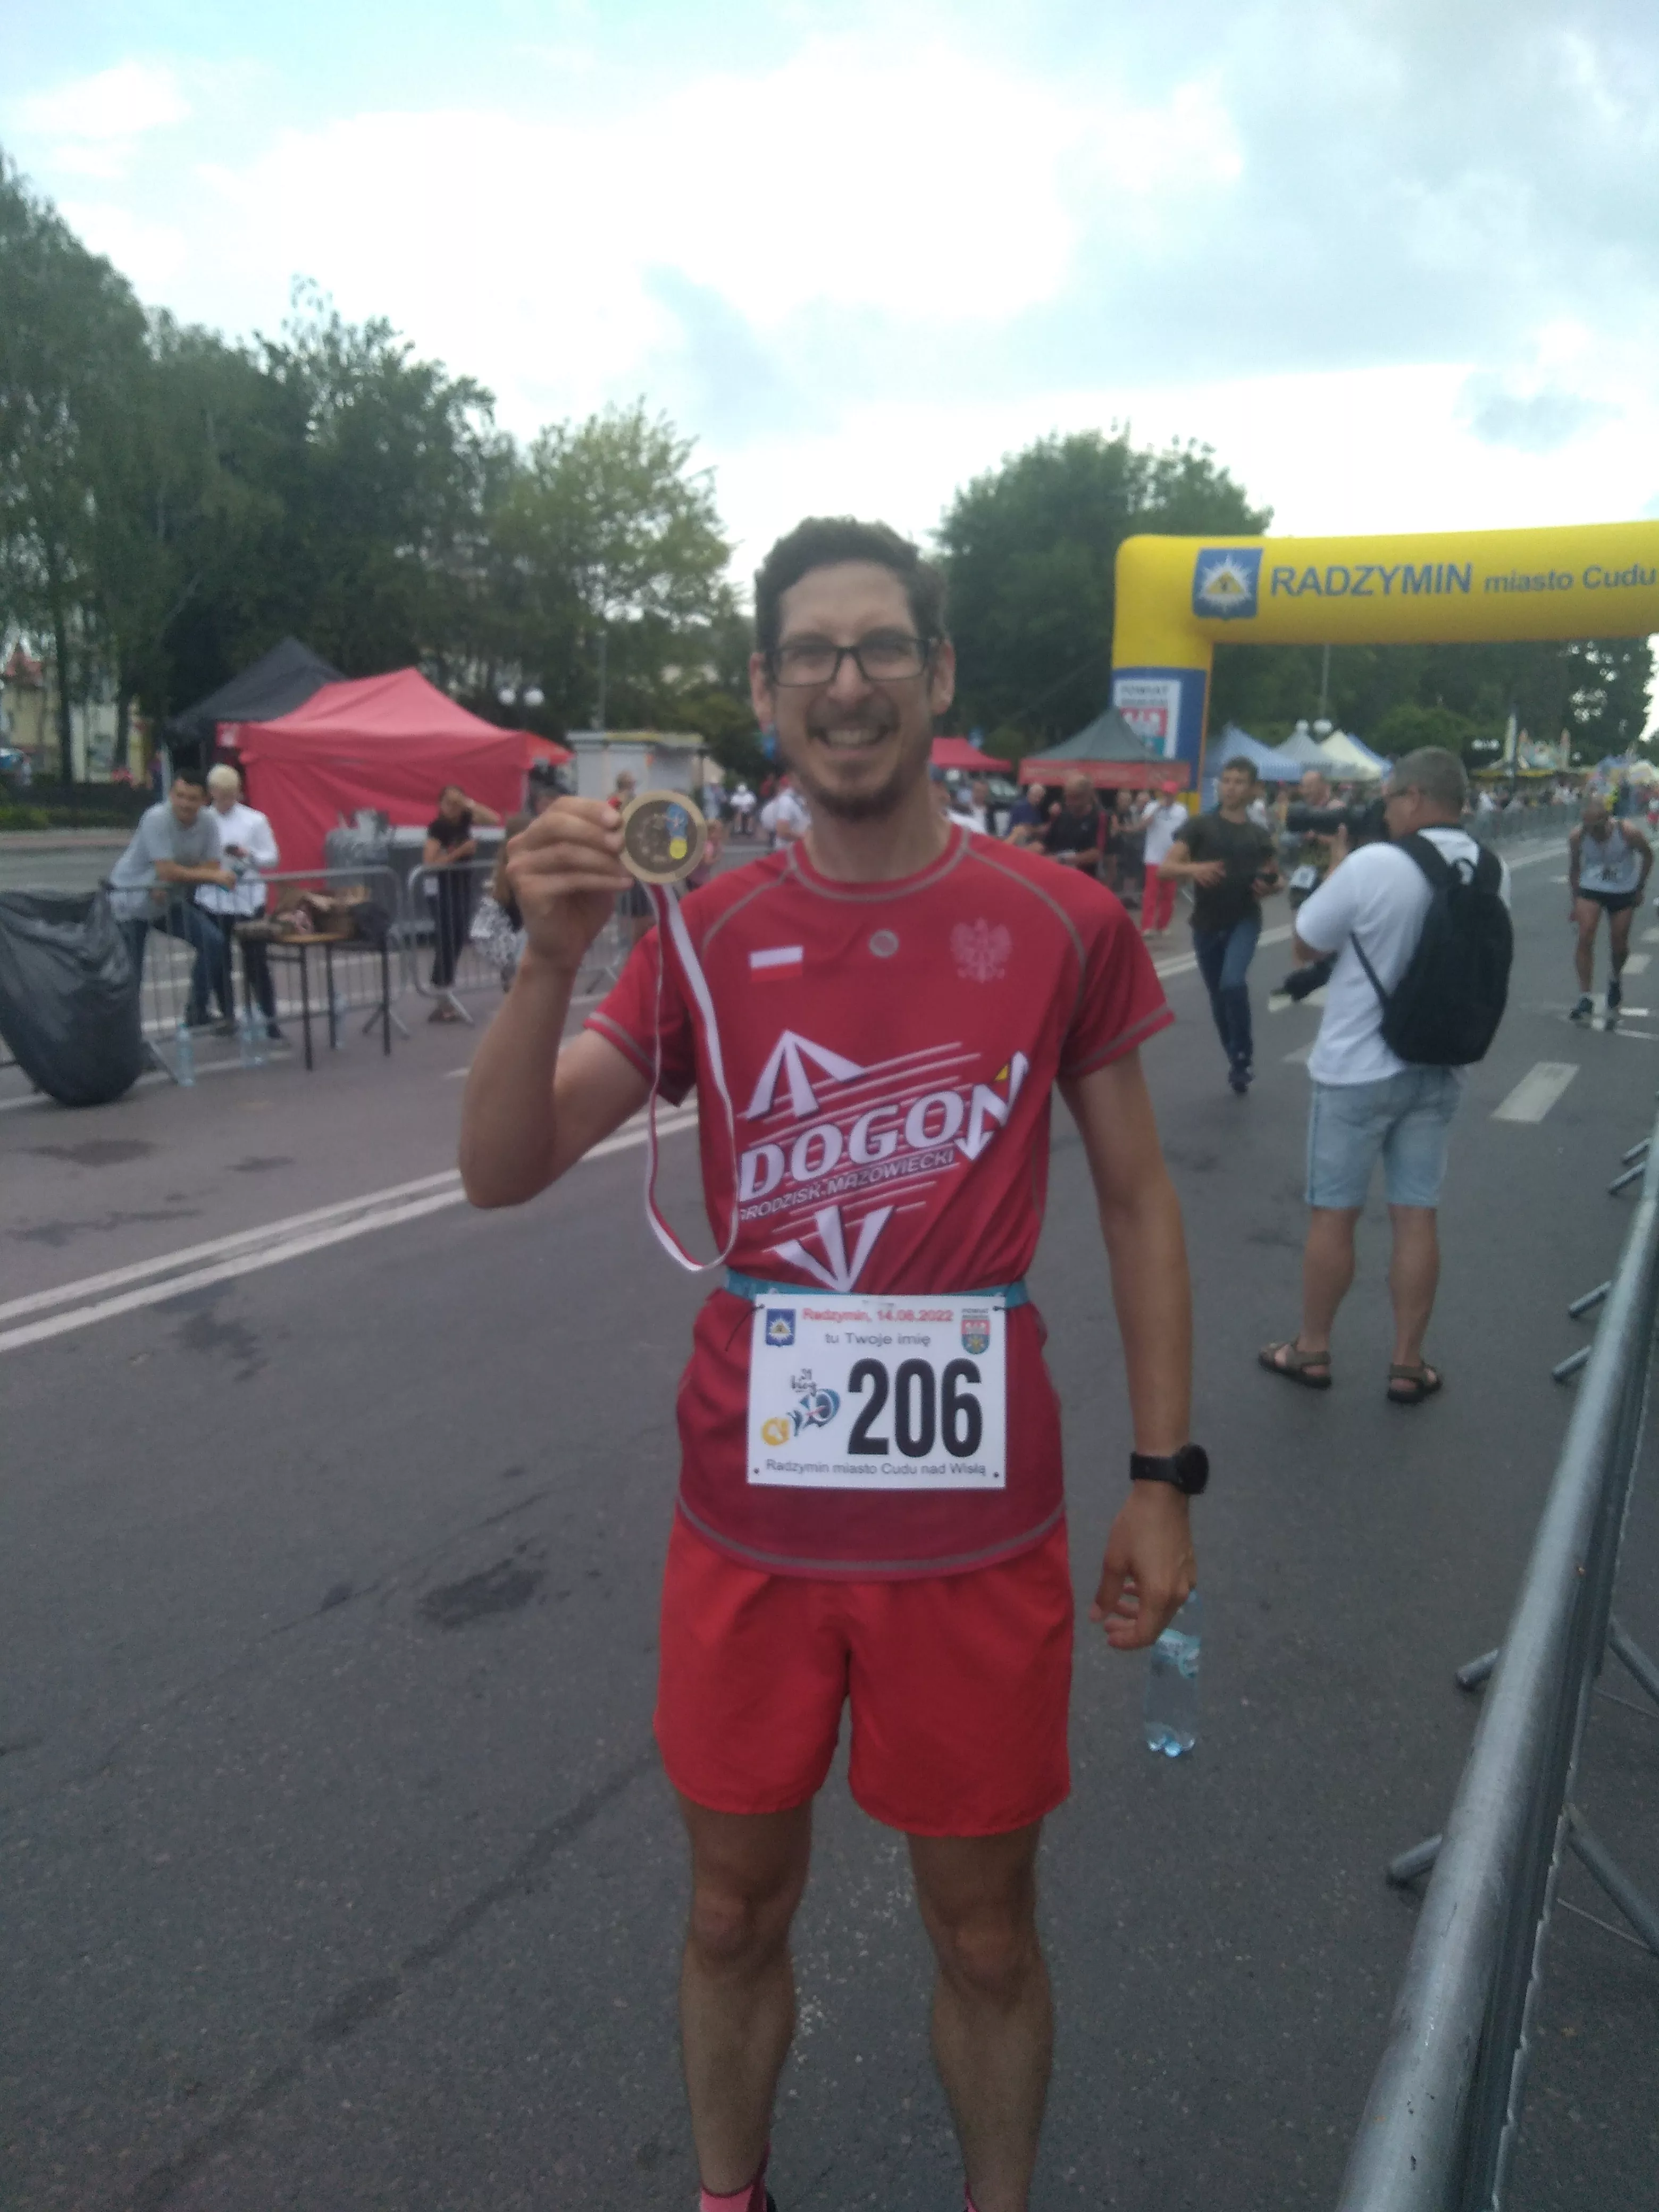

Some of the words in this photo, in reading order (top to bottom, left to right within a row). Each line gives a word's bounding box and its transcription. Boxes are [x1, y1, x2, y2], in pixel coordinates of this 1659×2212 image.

[1270, 562, 1473, 597] RADZYMIN
[1484, 567, 1573, 593] miasto
[1582, 562, 1657, 590] Cudu
[739, 1050, 1029, 1203] DOGON
[825, 1333, 839, 1344] tu
[846, 1333, 892, 1347] Twoje
[898, 1333, 931, 1347] imię
[848, 1357, 983, 1458] 206
[766, 1459, 830, 1474] Radzymin
[833, 1462, 877, 1474] miasto
[881, 1462, 918, 1474] Cudu
[921, 1463, 946, 1474] nad
[949, 1463, 987, 1477] Wisłą
